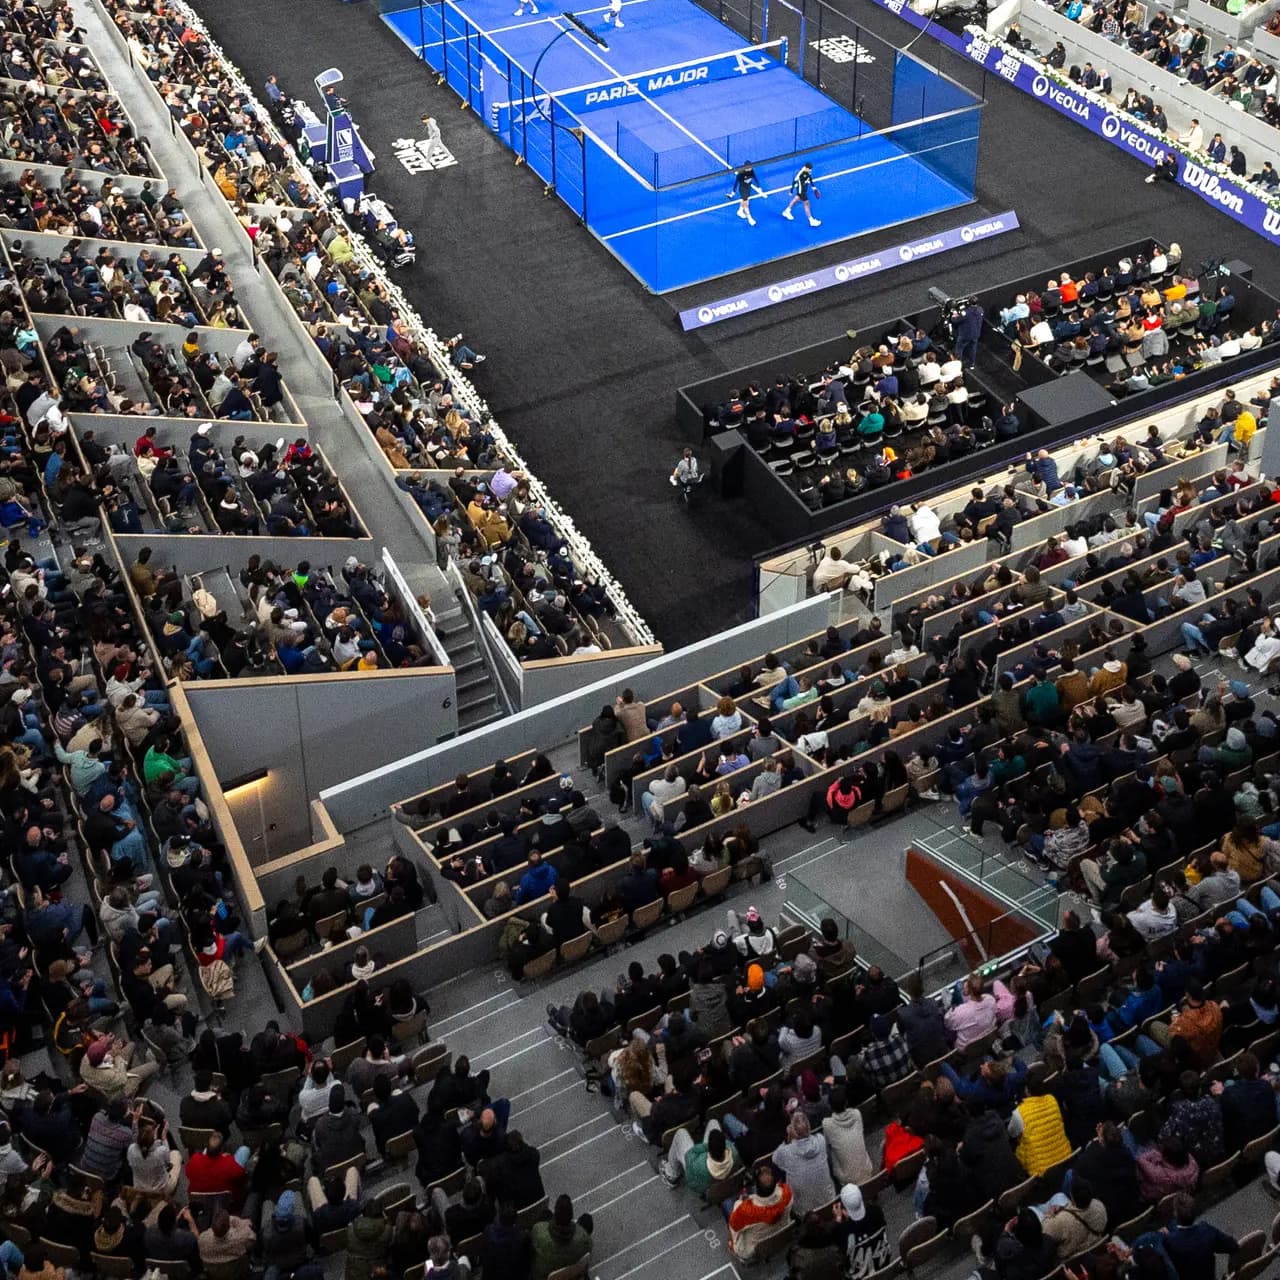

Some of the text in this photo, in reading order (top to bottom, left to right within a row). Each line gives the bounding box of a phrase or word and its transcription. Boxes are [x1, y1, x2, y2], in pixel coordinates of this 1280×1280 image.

[584, 66, 709, 105] PARIS MAJOR
[1048, 86, 1089, 120] VEOLIA
[1120, 128, 1165, 162] VEOLIA
[1183, 161, 1244, 215] Wilson
[972, 220, 1004, 238] VEOLIA
[911, 240, 944, 257] VEOLIA
[848, 259, 882, 276] VEOLIA
[782, 279, 816, 297] VEOLIA
[712, 299, 749, 318] VEOLIA
[442, 696, 452, 710] 6
[704, 1229, 722, 1250] 08
